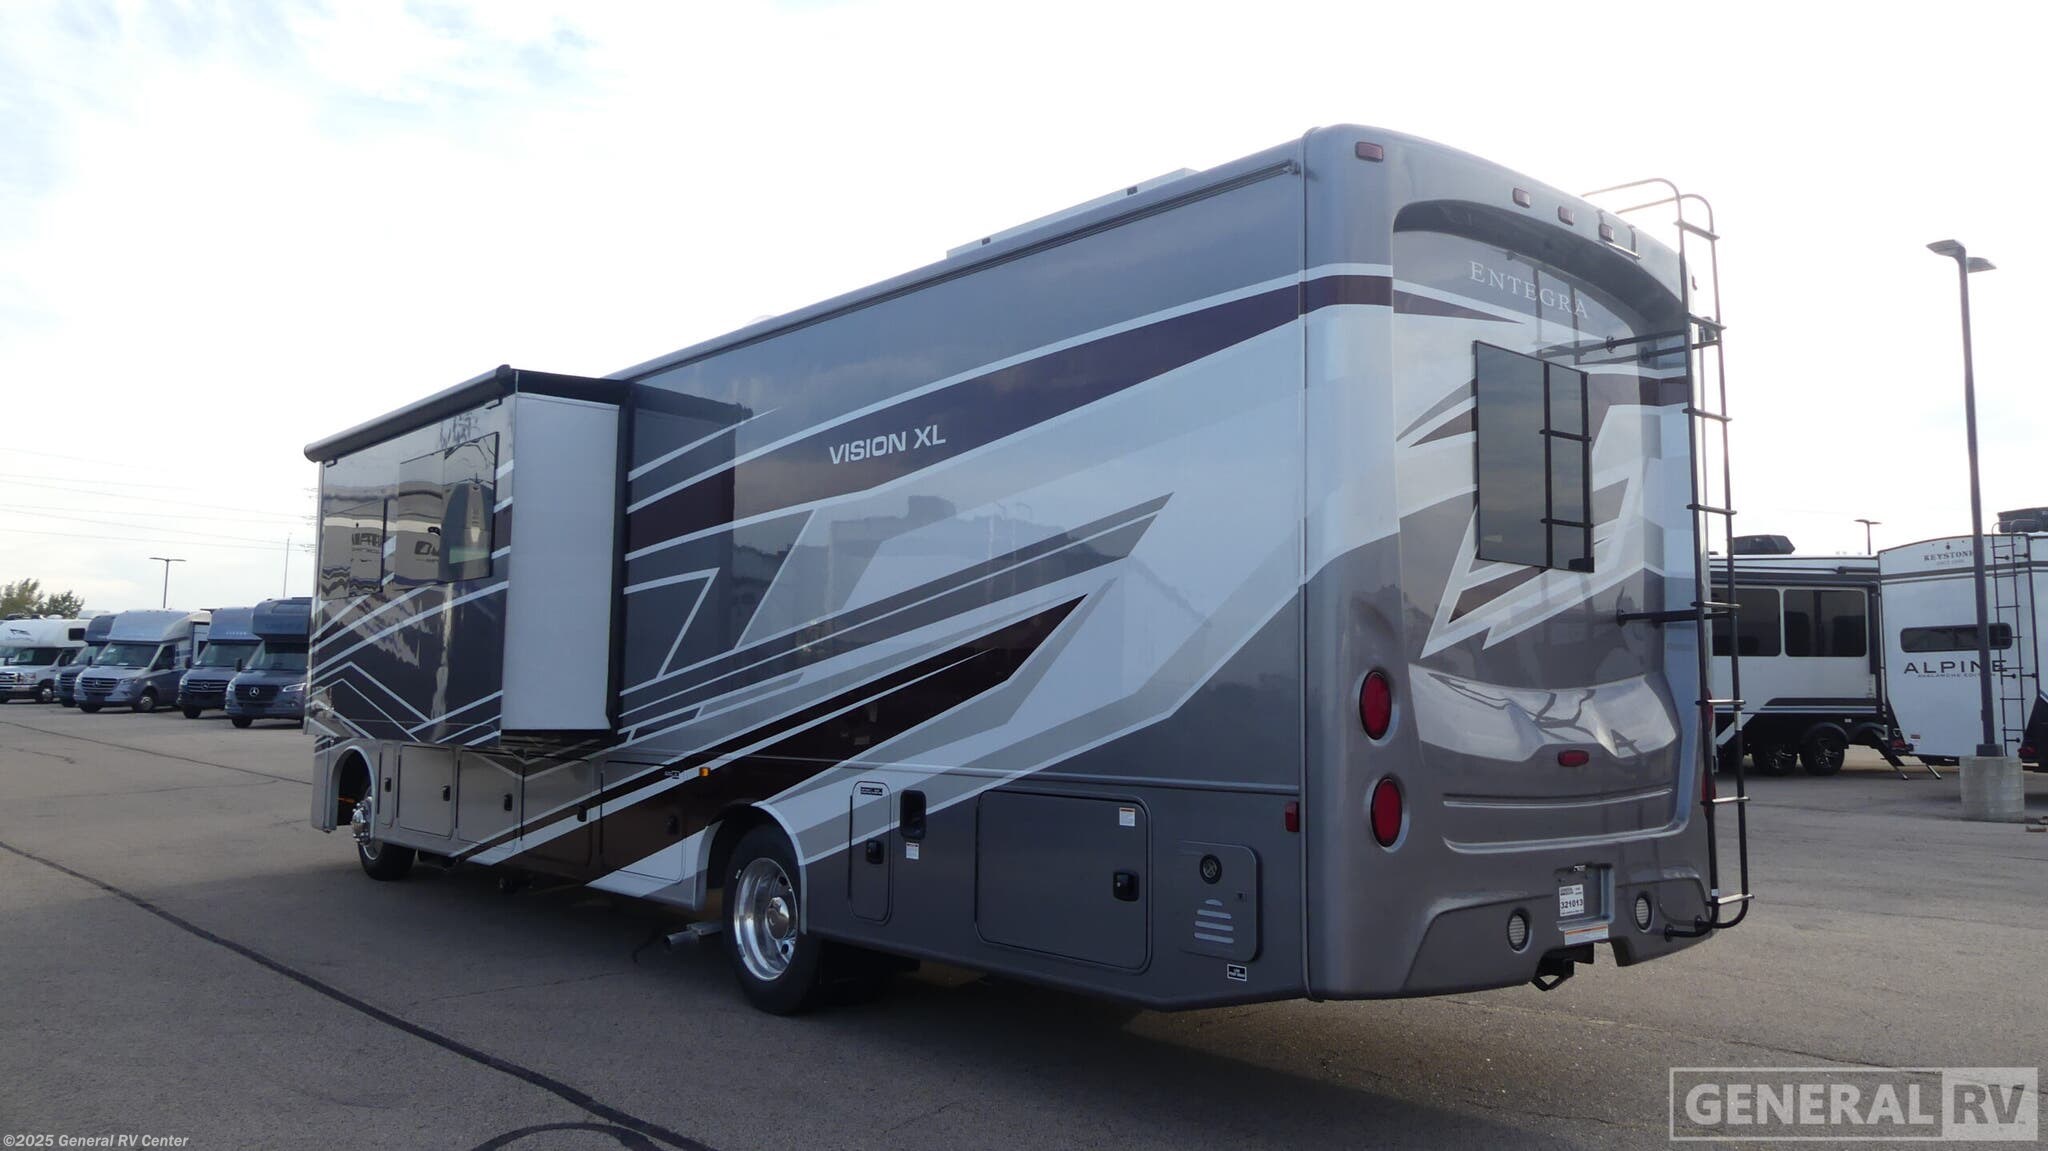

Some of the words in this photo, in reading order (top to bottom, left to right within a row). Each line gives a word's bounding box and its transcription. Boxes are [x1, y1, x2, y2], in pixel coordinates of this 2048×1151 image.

[1470, 260, 1589, 319] ENTEGRA
[829, 431, 907, 465] VISION
[913, 423, 947, 449] XL
[1903, 660, 2008, 674] ALPINE
[1560, 898, 1584, 909] 321013
